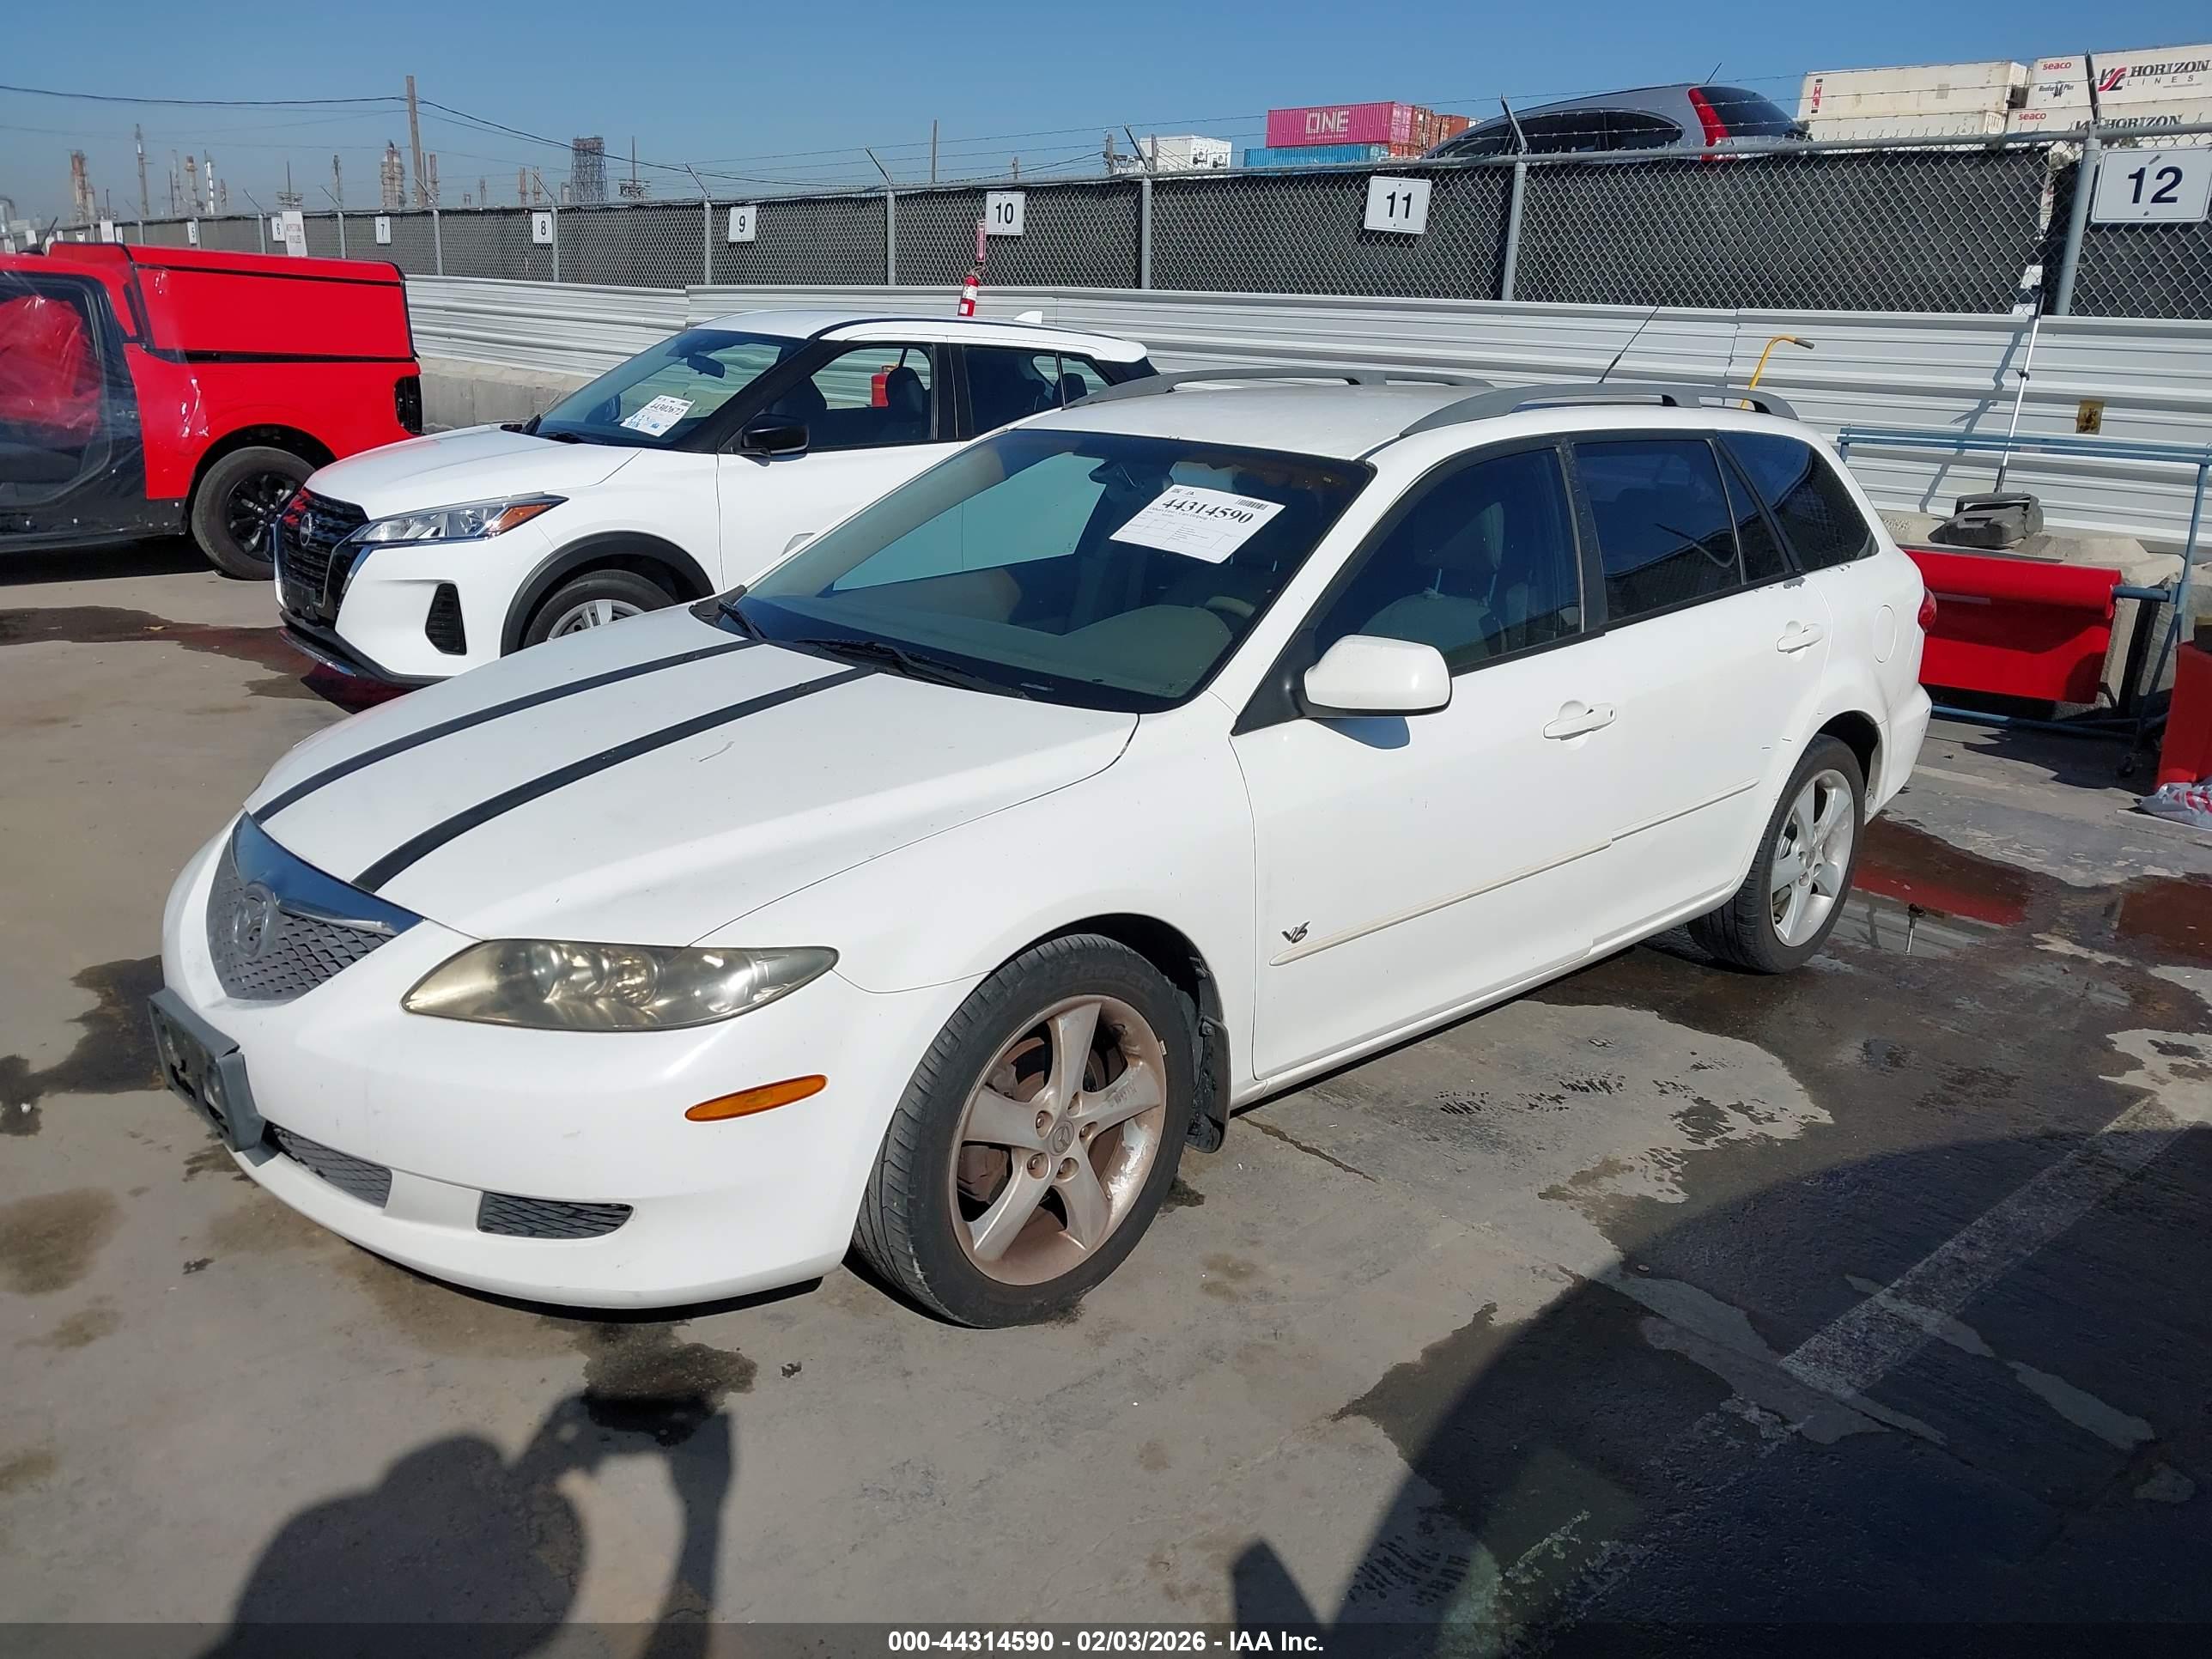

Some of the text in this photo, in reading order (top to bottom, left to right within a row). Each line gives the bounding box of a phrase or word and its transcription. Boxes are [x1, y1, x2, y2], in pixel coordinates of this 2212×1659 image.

[2042, 61, 2071, 70] seaco
[2130, 60, 2210, 77] HORIZON
[2127, 75, 2194, 87] LINES
[1305, 110, 1349, 134] ONE
[2018, 112, 2047, 121] seaco
[2128, 166, 2184, 204] 12
[995, 202, 1014, 225] 10
[1386, 191, 1413, 220] 11
[191, 226, 196, 239] 5
[276, 222, 282, 236] 6
[380, 223, 386, 238] 7
[540, 220, 546, 236] 8
[738, 215, 746, 233] 9
[1162, 498, 1254, 524] 44314590
[1281, 921, 1310, 944] V6
